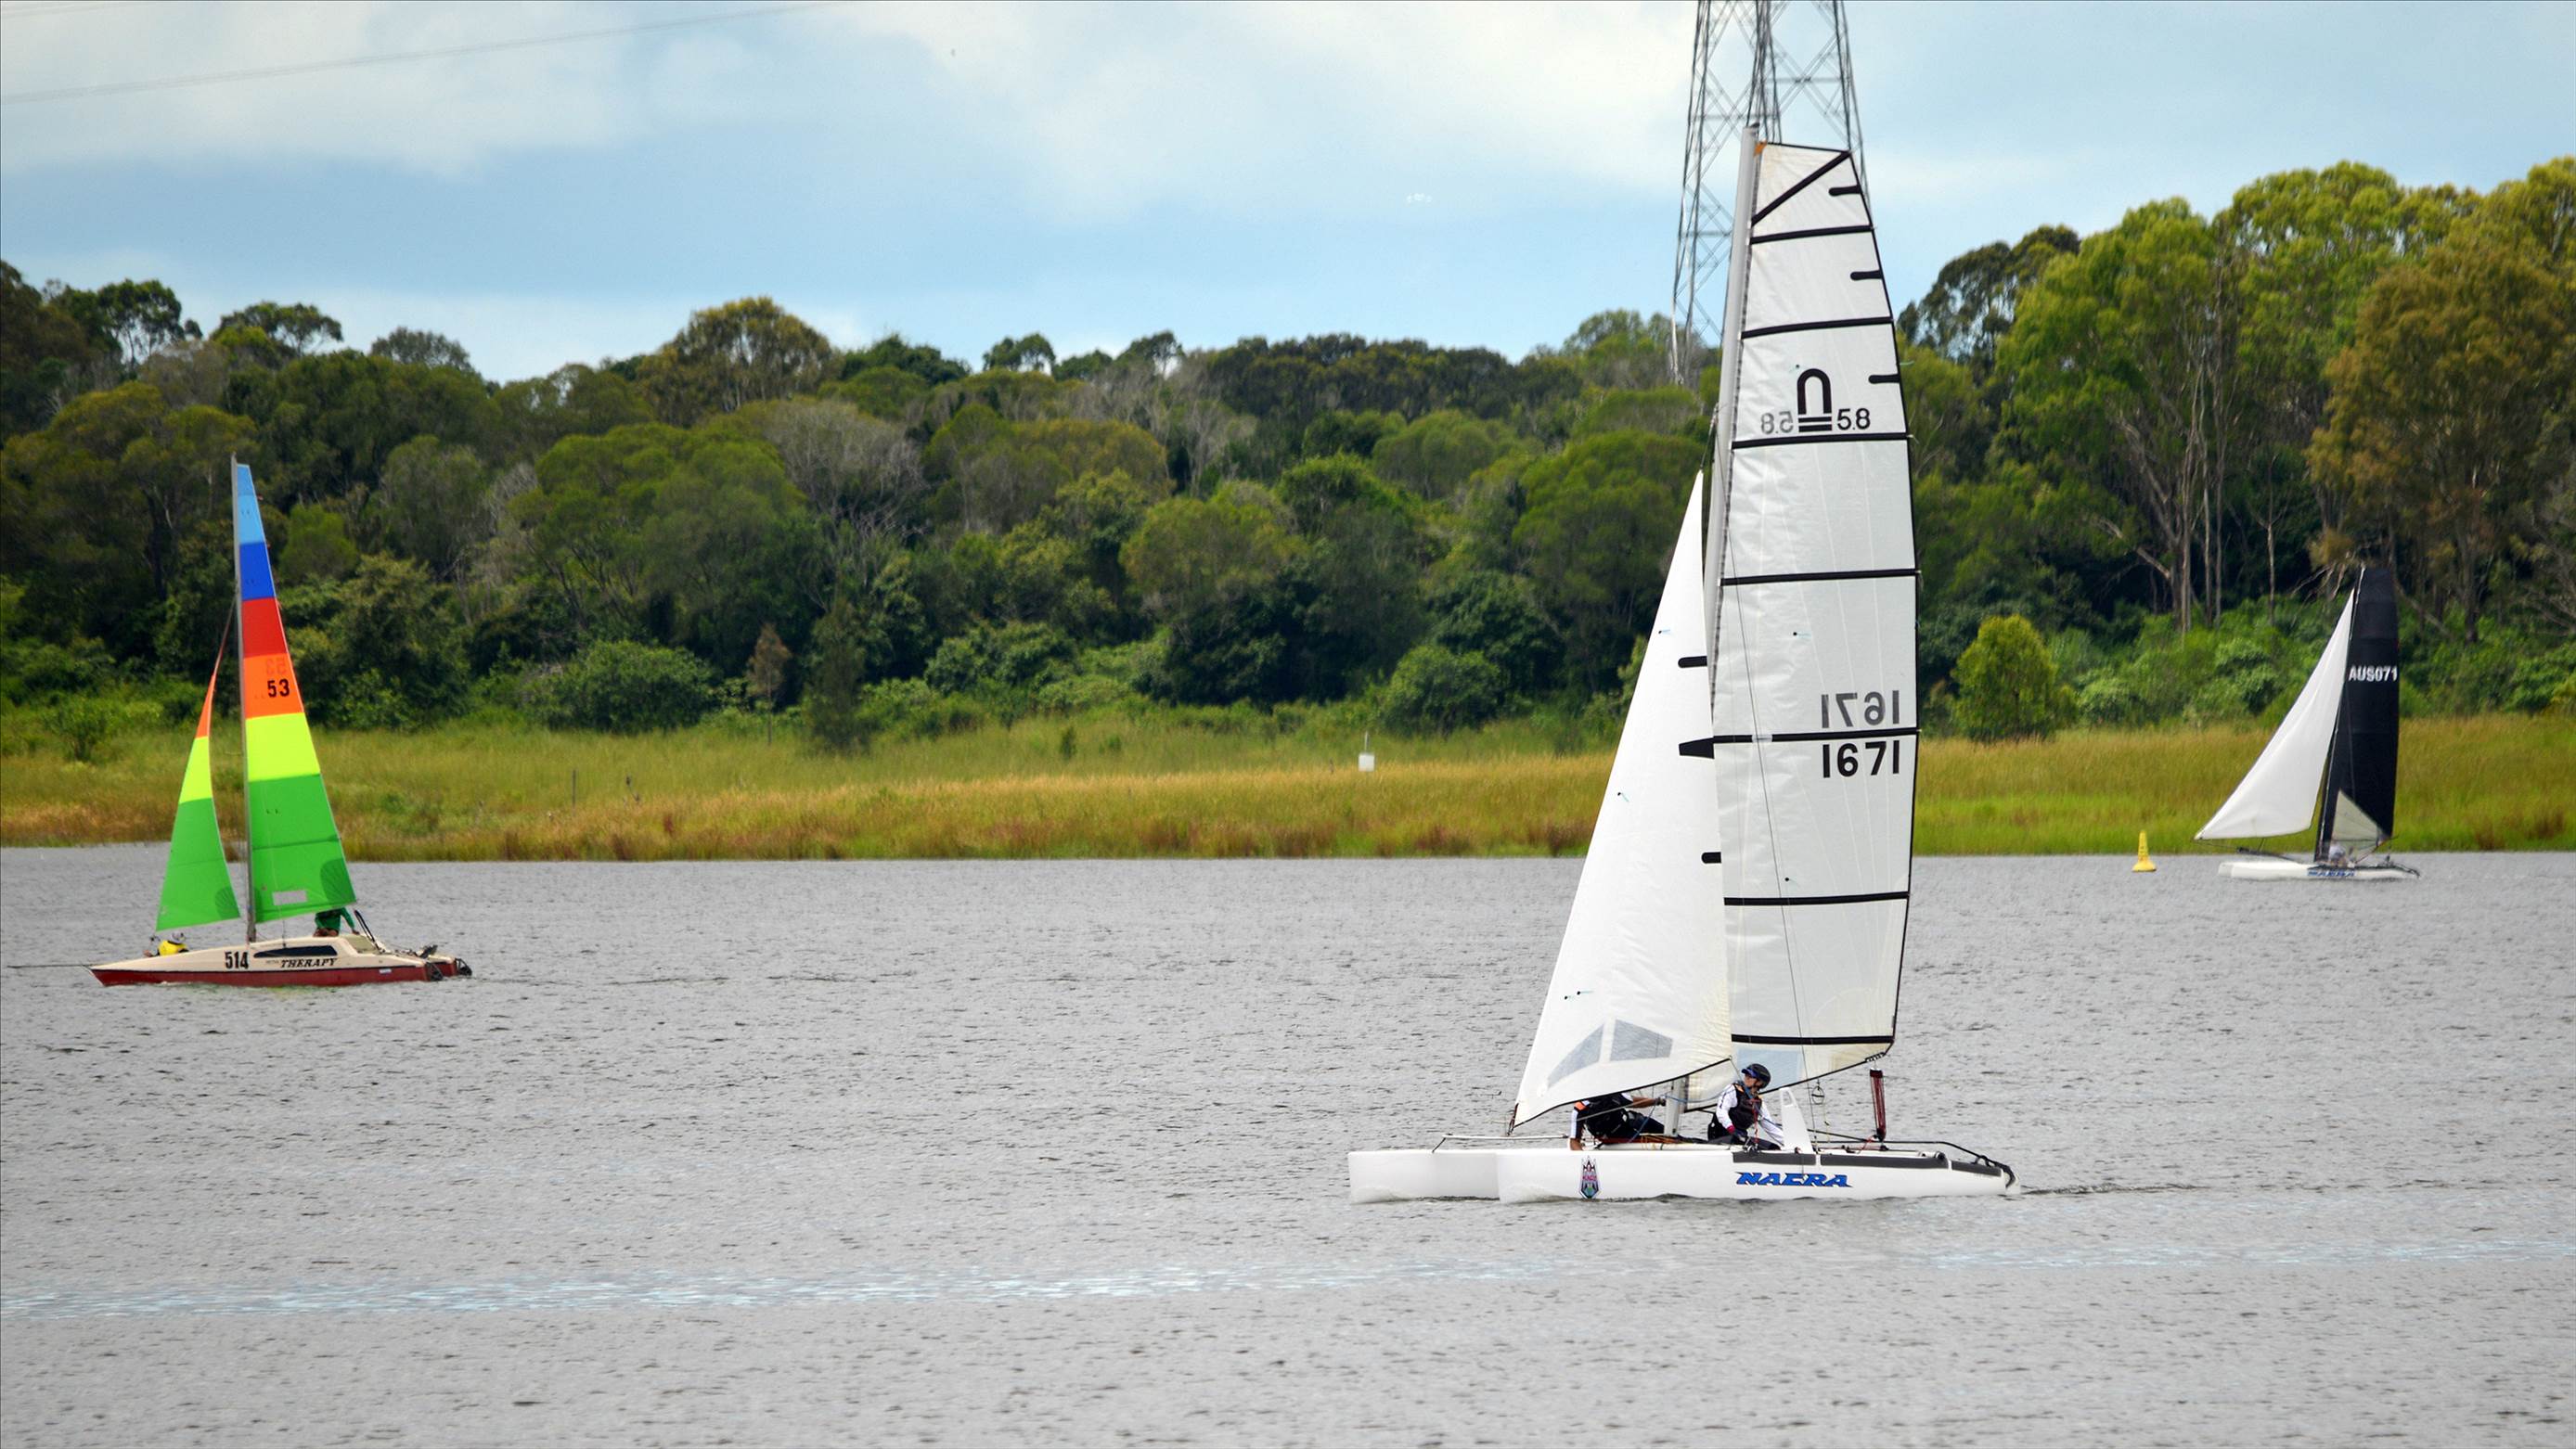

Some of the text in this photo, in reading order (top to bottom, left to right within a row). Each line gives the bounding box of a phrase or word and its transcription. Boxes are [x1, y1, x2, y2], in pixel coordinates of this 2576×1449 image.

[1837, 407, 1871, 430] 5.8
[2348, 665, 2398, 682] AUS071
[267, 678, 290, 698] 53
[1823, 740, 1900, 778] 1671
[225, 951, 249, 969] 514
[281, 957, 337, 968] THERAPY
